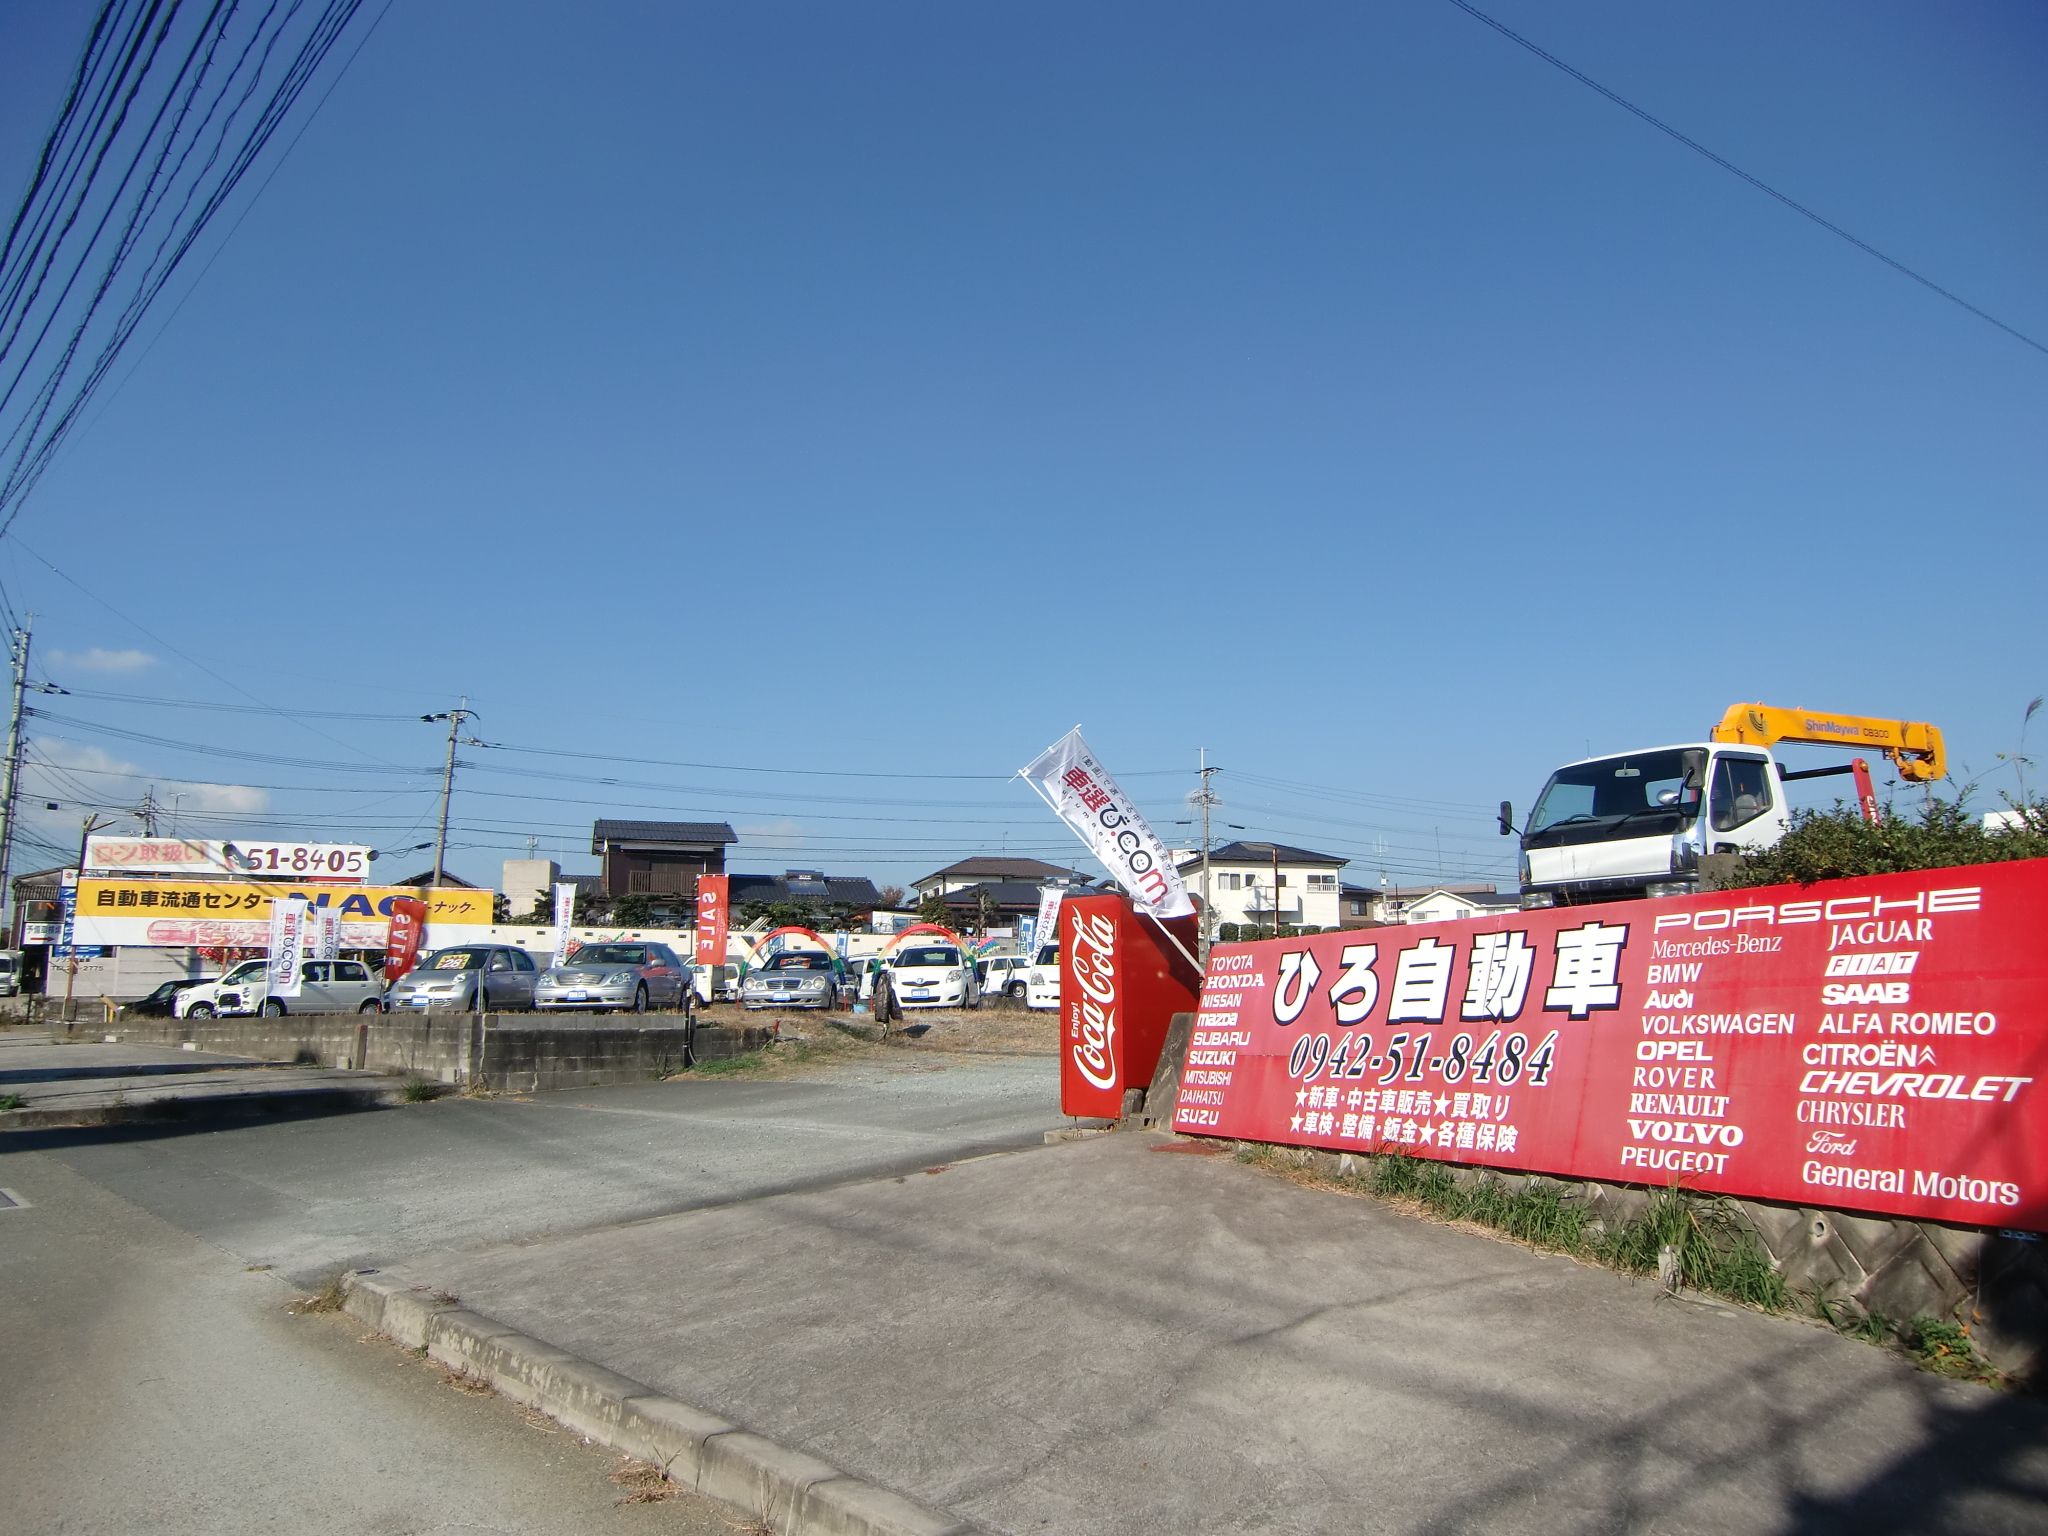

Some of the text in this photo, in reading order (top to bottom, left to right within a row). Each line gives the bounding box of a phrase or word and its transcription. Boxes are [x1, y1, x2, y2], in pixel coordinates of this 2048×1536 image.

[1806, 719, 1859, 736] ShinMaywa
[247, 847, 362, 872] 51-8405
[97, 889, 277, 909] 自動車流通センター
[1654, 887, 1981, 934] PORSCHE
[1651, 932, 1782, 960] Mercedes-Benz
[1827, 918, 1933, 951] JAGUAR
[1211, 954, 1254, 971] TOYOTA
[1272, 920, 1630, 1027] ひろ自動車
[1646, 962, 1703, 984] BMW
[1825, 951, 1919, 977] FIAT
[1206, 973, 1265, 989] HONDA
[1072, 904, 1116, 1090] Coca-Cola
[1201, 993, 1242, 1008] NISSAN
[1644, 989, 1694, 1010] Audi
[1821, 982, 1910, 1006] SAAB
[1071, 1002, 1080, 1038] Enjoy!
[1641, 1013, 1795, 1035] VOLKSWAGEN
[1818, 1012, 1996, 1035] ALFA ROMEO
[1193, 1032, 1251, 1046] SUBARU
[1189, 1050, 1237, 1066] SUZUKI
[1289, 1030, 1559, 1086] 0942-51-8484
[1636, 1041, 1713, 1062] OPEL
[1802, 1039, 1917, 1067] CITROËN
[1184, 1070, 1232, 1086] MITSUBISHI
[1633, 1066, 1716, 1090] ROVER
[1799, 1070, 2033, 1102] CHEVROLET
[1180, 1089, 1224, 1105] DAIHATSU
[1629, 1093, 1730, 1118] RENAULT
[1176, 1108, 1219, 1126] ISUZU
[1796, 1099, 1906, 1129] CHRYSLER
[1627, 1119, 1744, 1147] VOLVO
[1806, 1130, 1857, 1157] Ford
[1621, 1146, 1730, 1175] PEUGEOT
[1802, 1161, 2020, 1207] General Motors
